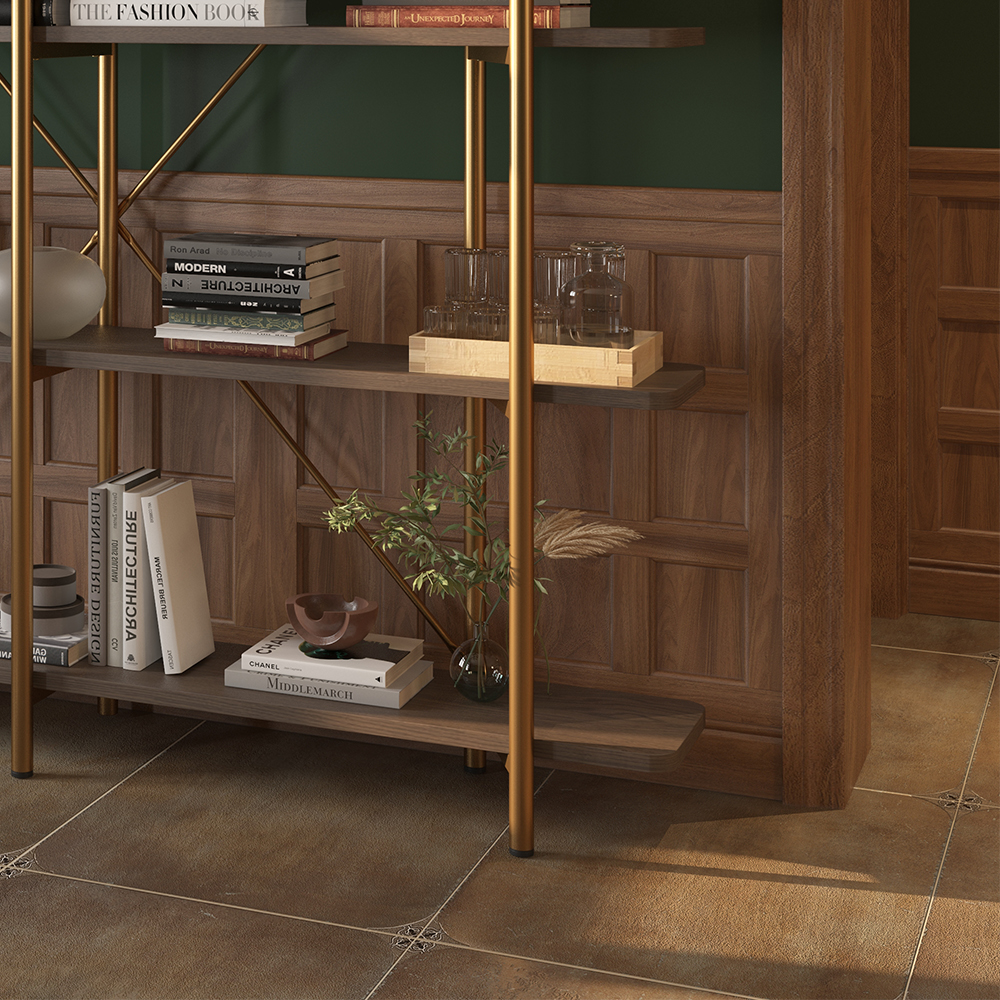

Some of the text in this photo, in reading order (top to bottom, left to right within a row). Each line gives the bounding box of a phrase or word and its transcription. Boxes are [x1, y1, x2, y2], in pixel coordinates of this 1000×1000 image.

[73, 3, 260, 20] THE FASHION BOOK
[411, 13, 495, 26] UNEXPECTED JOURNEY
[190, 246, 210, 254] Arad
[174, 262, 227, 273] MODERN
[201, 279, 300, 295] ARCHITECTURE
[256, 628, 298, 655] CHANE
[249, 660, 280, 670] CHANEL
[266, 676, 353, 700] MIDDLEMARCH
